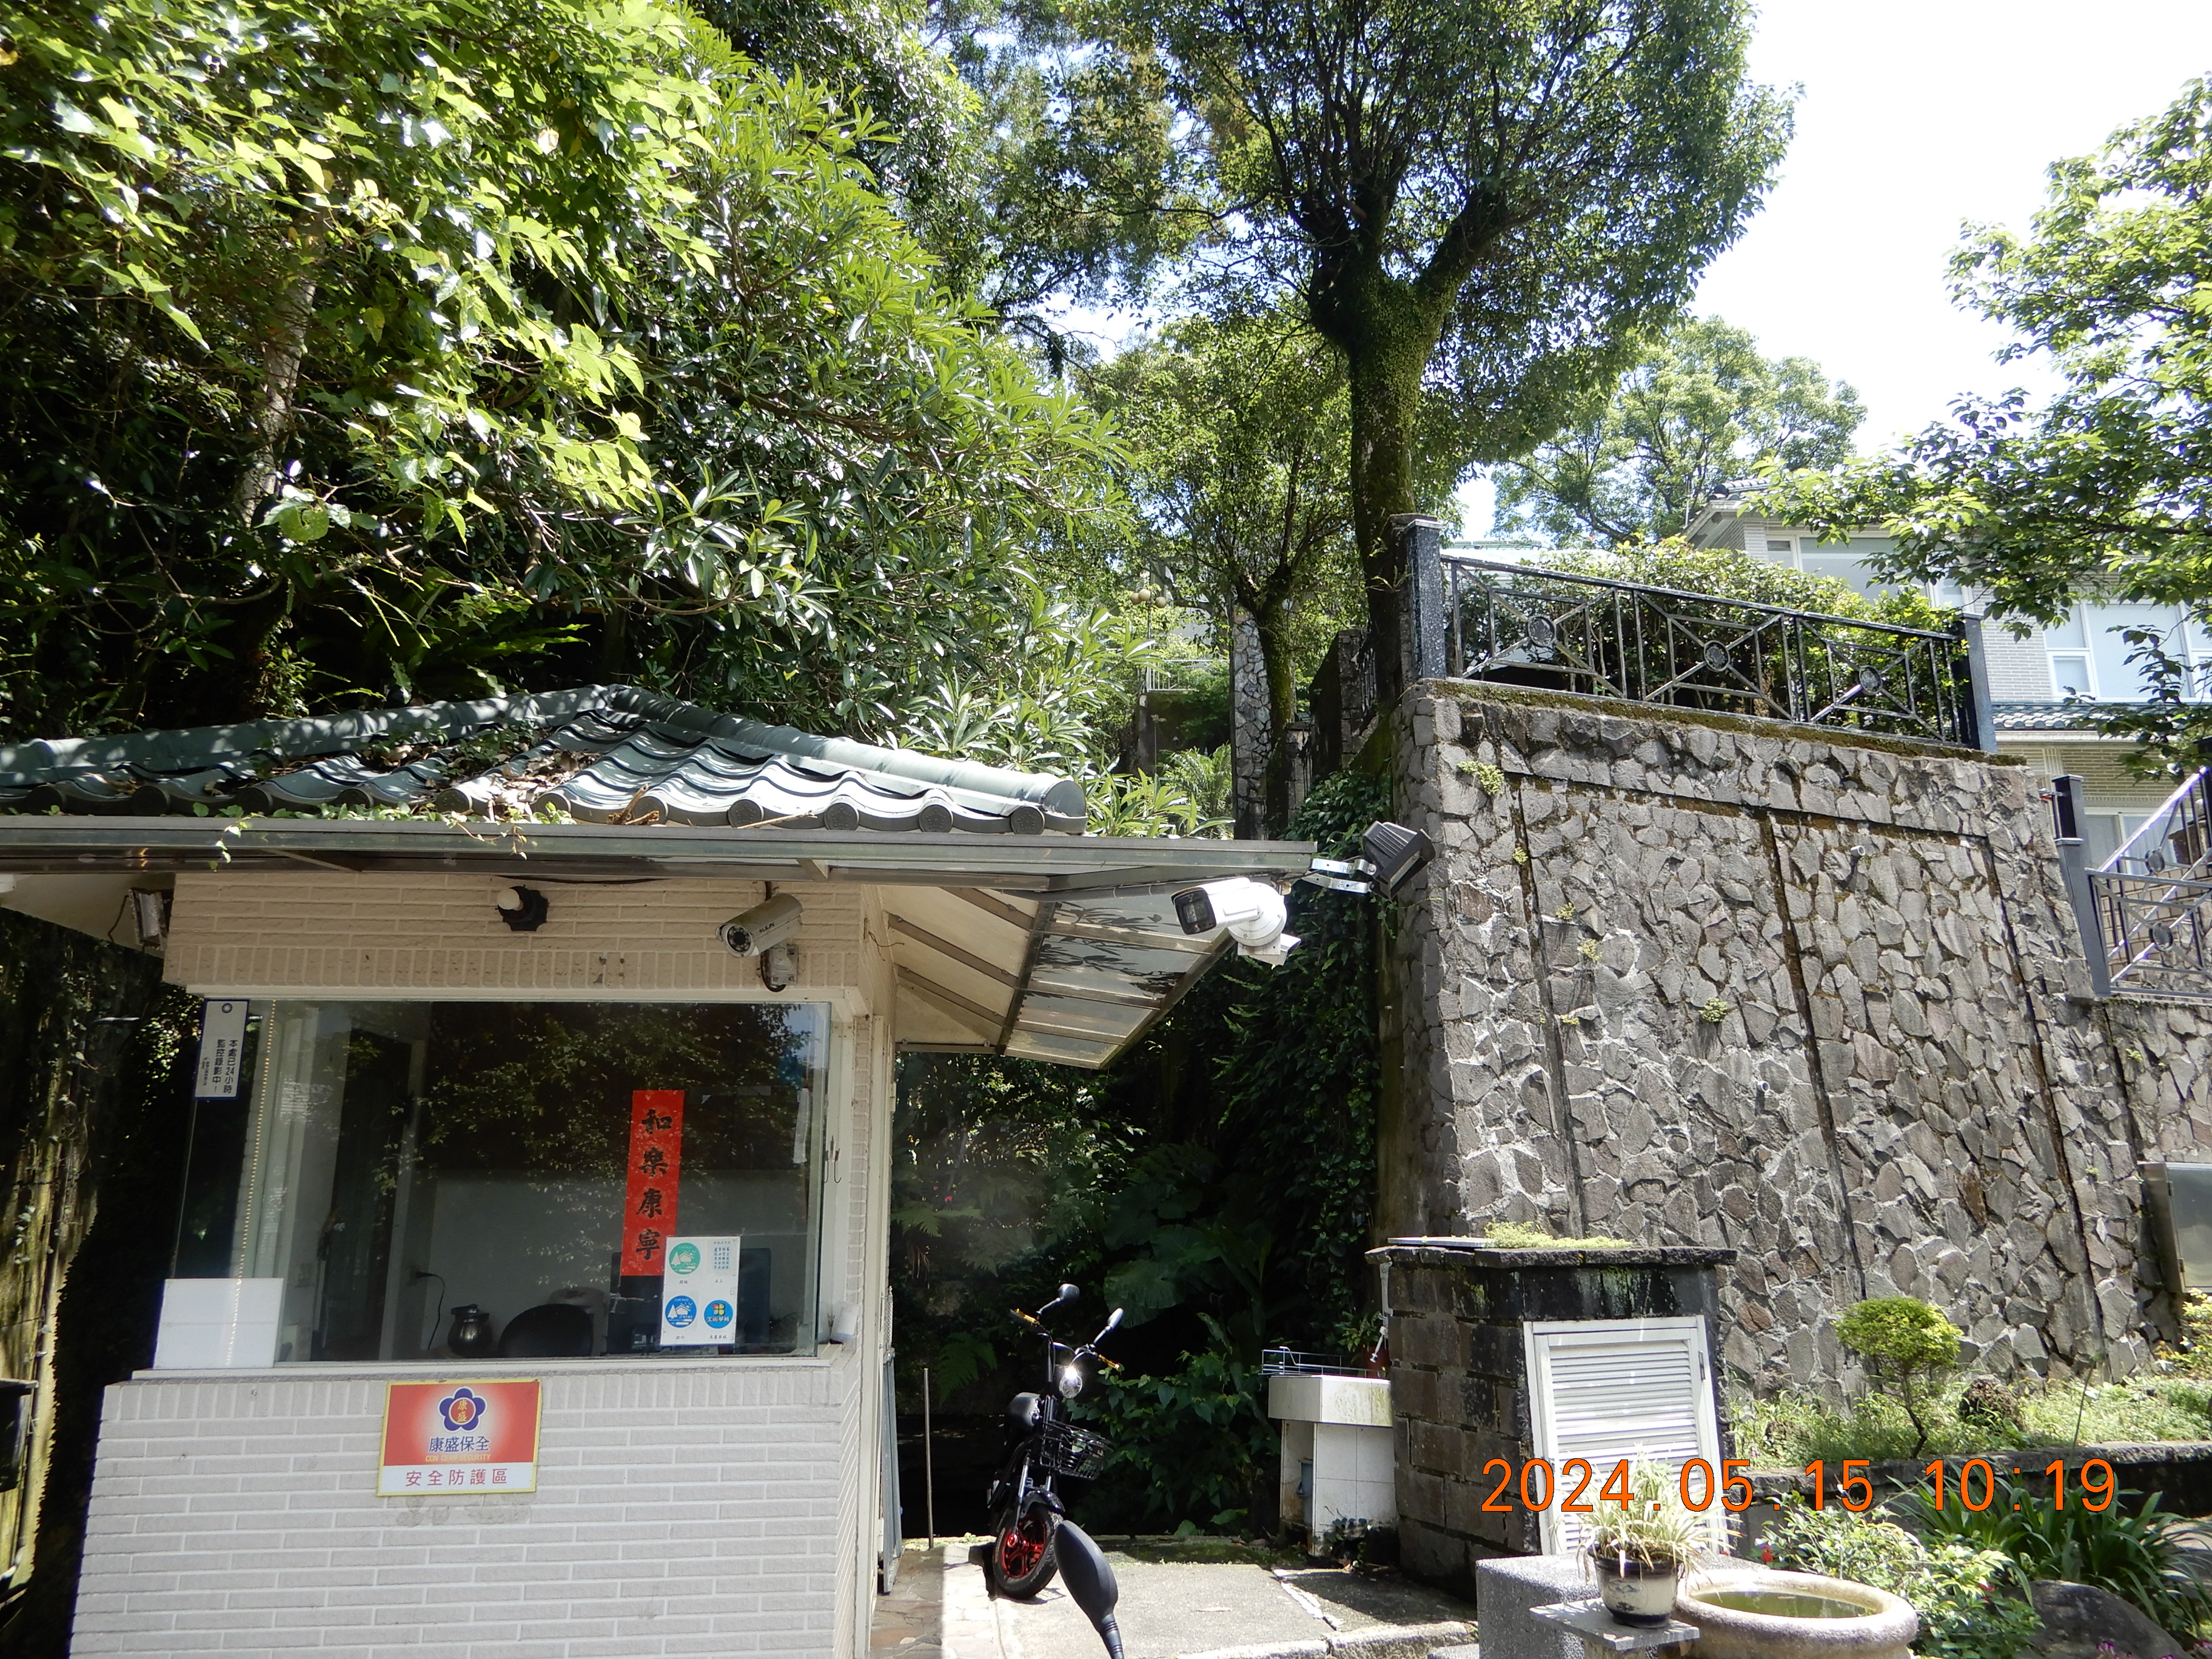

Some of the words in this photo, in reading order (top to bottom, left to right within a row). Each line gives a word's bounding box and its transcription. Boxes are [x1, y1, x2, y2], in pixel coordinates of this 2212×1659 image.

[457, 1399, 468, 1423] 康盛
[428, 1436, 490, 1453] 康盛保全
[406, 1468, 508, 1487] 安全防護區
